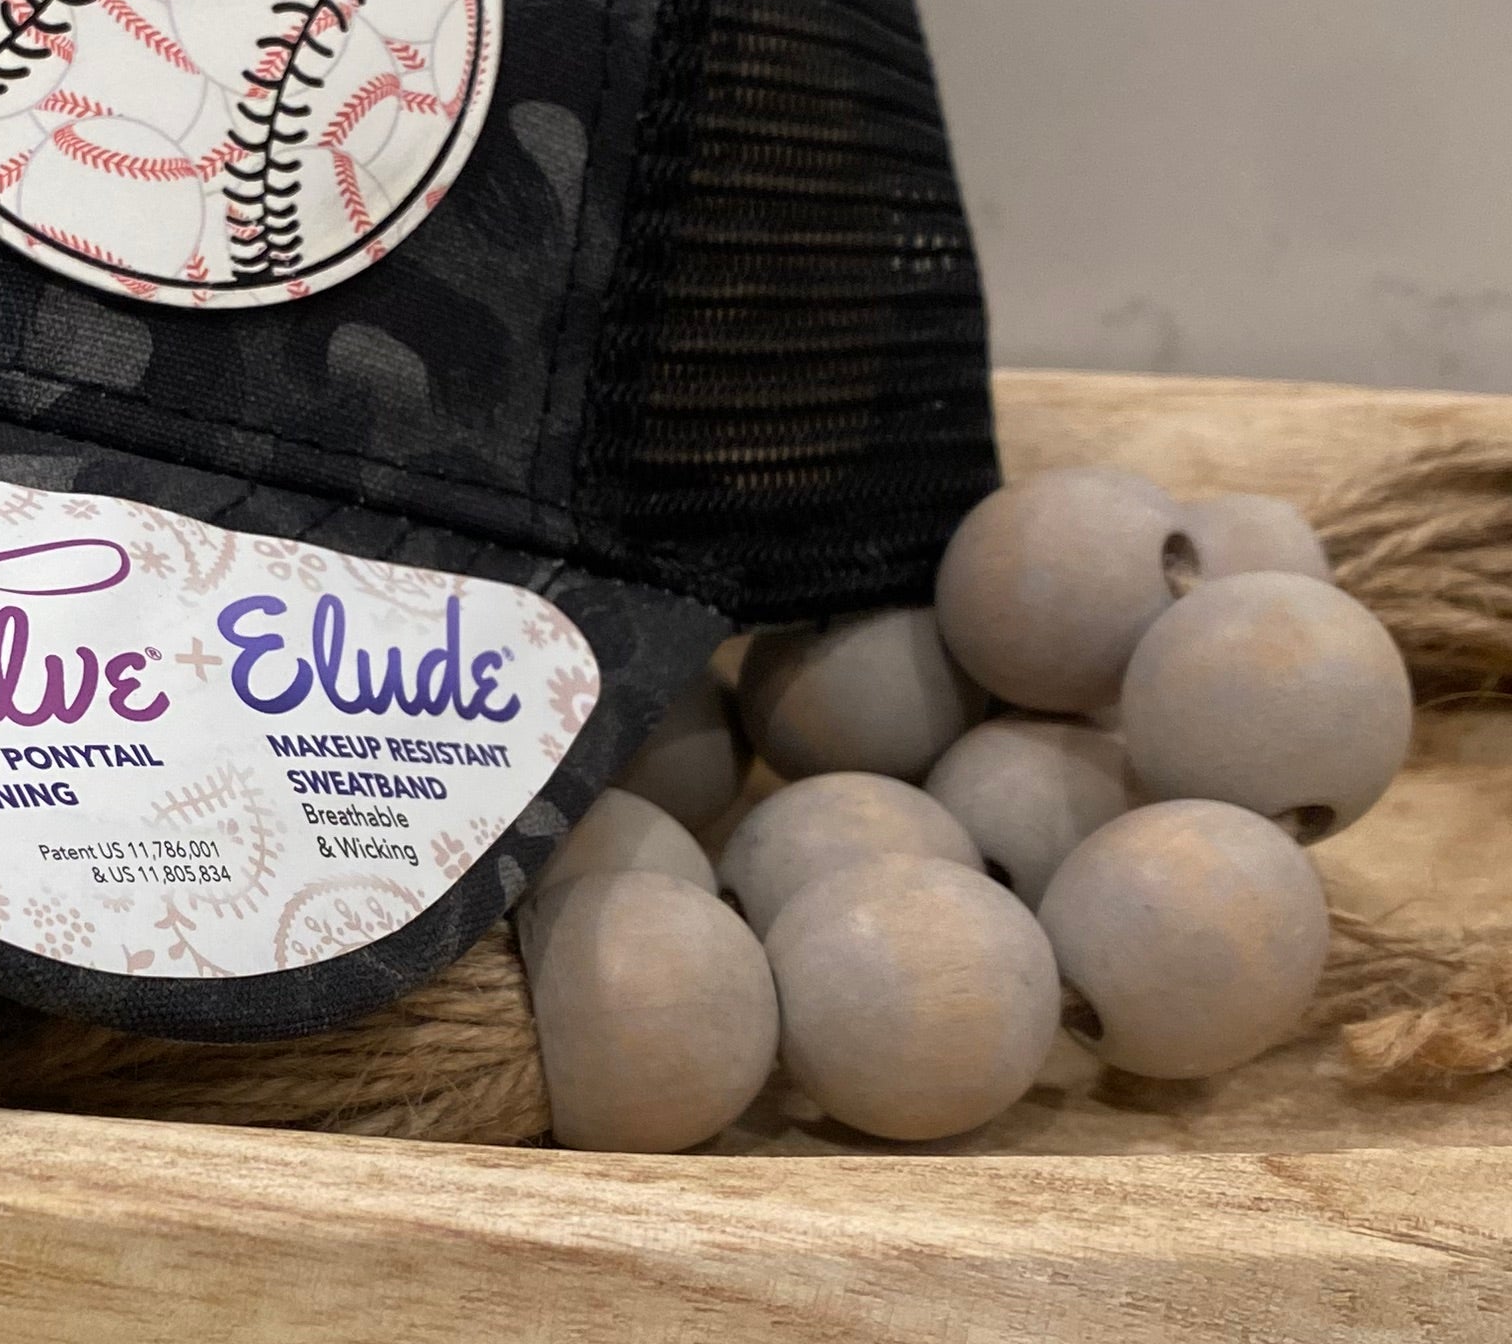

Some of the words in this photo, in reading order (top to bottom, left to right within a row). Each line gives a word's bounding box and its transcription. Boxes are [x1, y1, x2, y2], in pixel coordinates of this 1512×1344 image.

[0, 743, 165, 772] PONYTAIL
[266, 734, 381, 760] MAKEUP
[385, 736, 511, 768] RESISTANT
[286, 769, 448, 800] SWEATBAND
[301, 802, 410, 828] Breathable
[38, 844, 98, 861] Patent
[98, 842, 125, 860] US
[127, 840, 220, 861] 11,786,001
[316, 835, 337, 858] &
[334, 836, 419, 866] Wicking
[91, 866, 109, 883] &
[108, 866, 135, 883] US
[138, 864, 232, 885] 11,805,834
